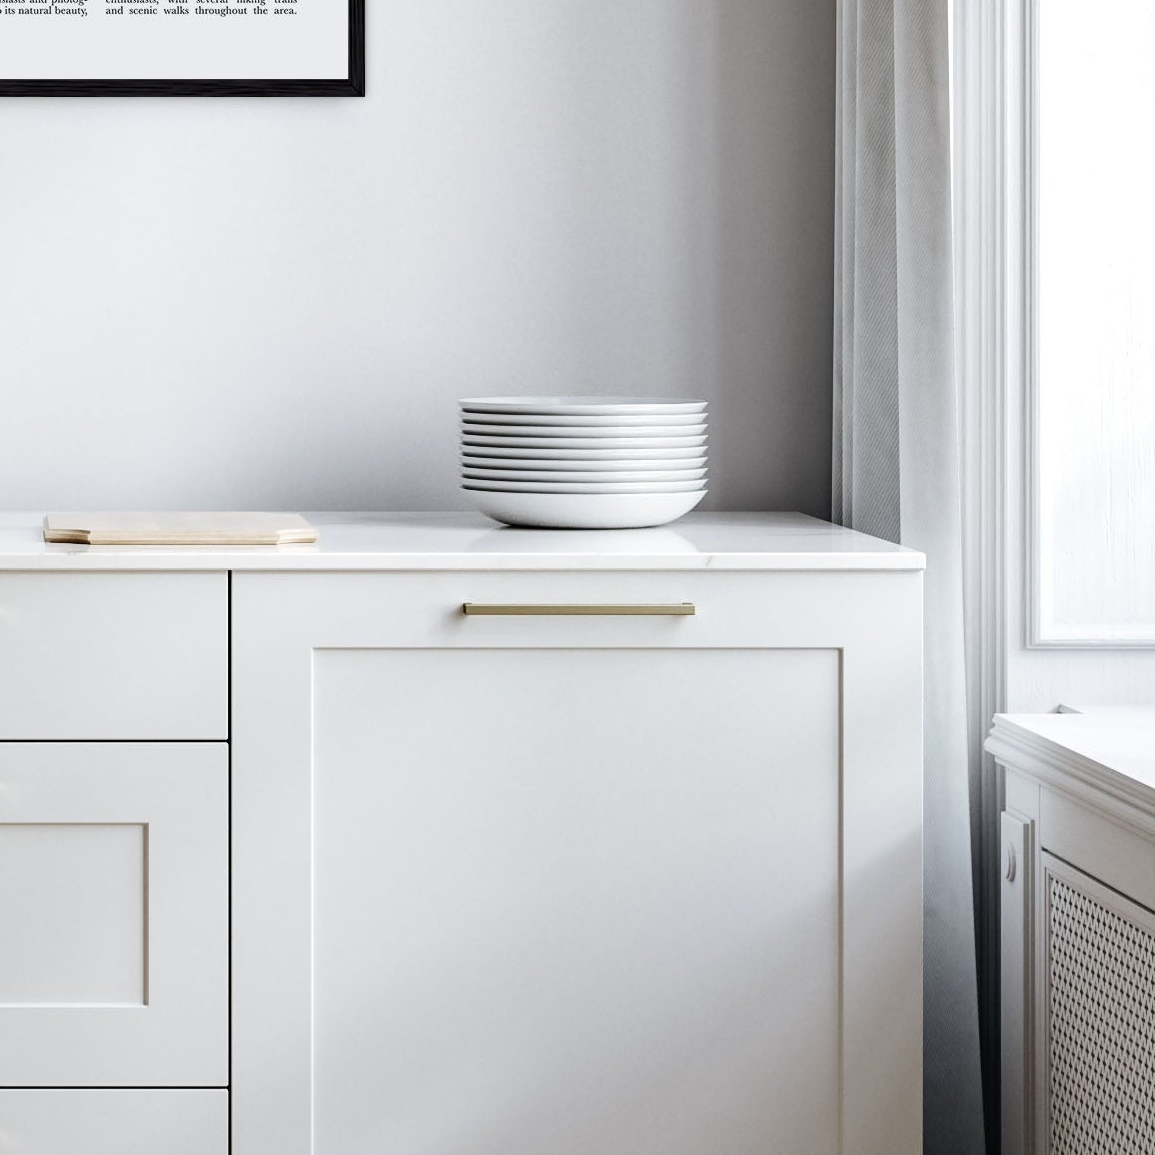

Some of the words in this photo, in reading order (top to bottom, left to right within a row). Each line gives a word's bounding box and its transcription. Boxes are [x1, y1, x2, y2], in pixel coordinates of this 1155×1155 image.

[4, 5, 16, 14] its
[17, 5, 53, 14] natural
[54, 5, 88, 16] beauty,
[105, 5, 124, 14] and
[128, 5, 158, 14] scenic
[163, 5, 190, 14] walks
[194, 5, 248, 16] throughout
[253, 5, 269, 14] the
